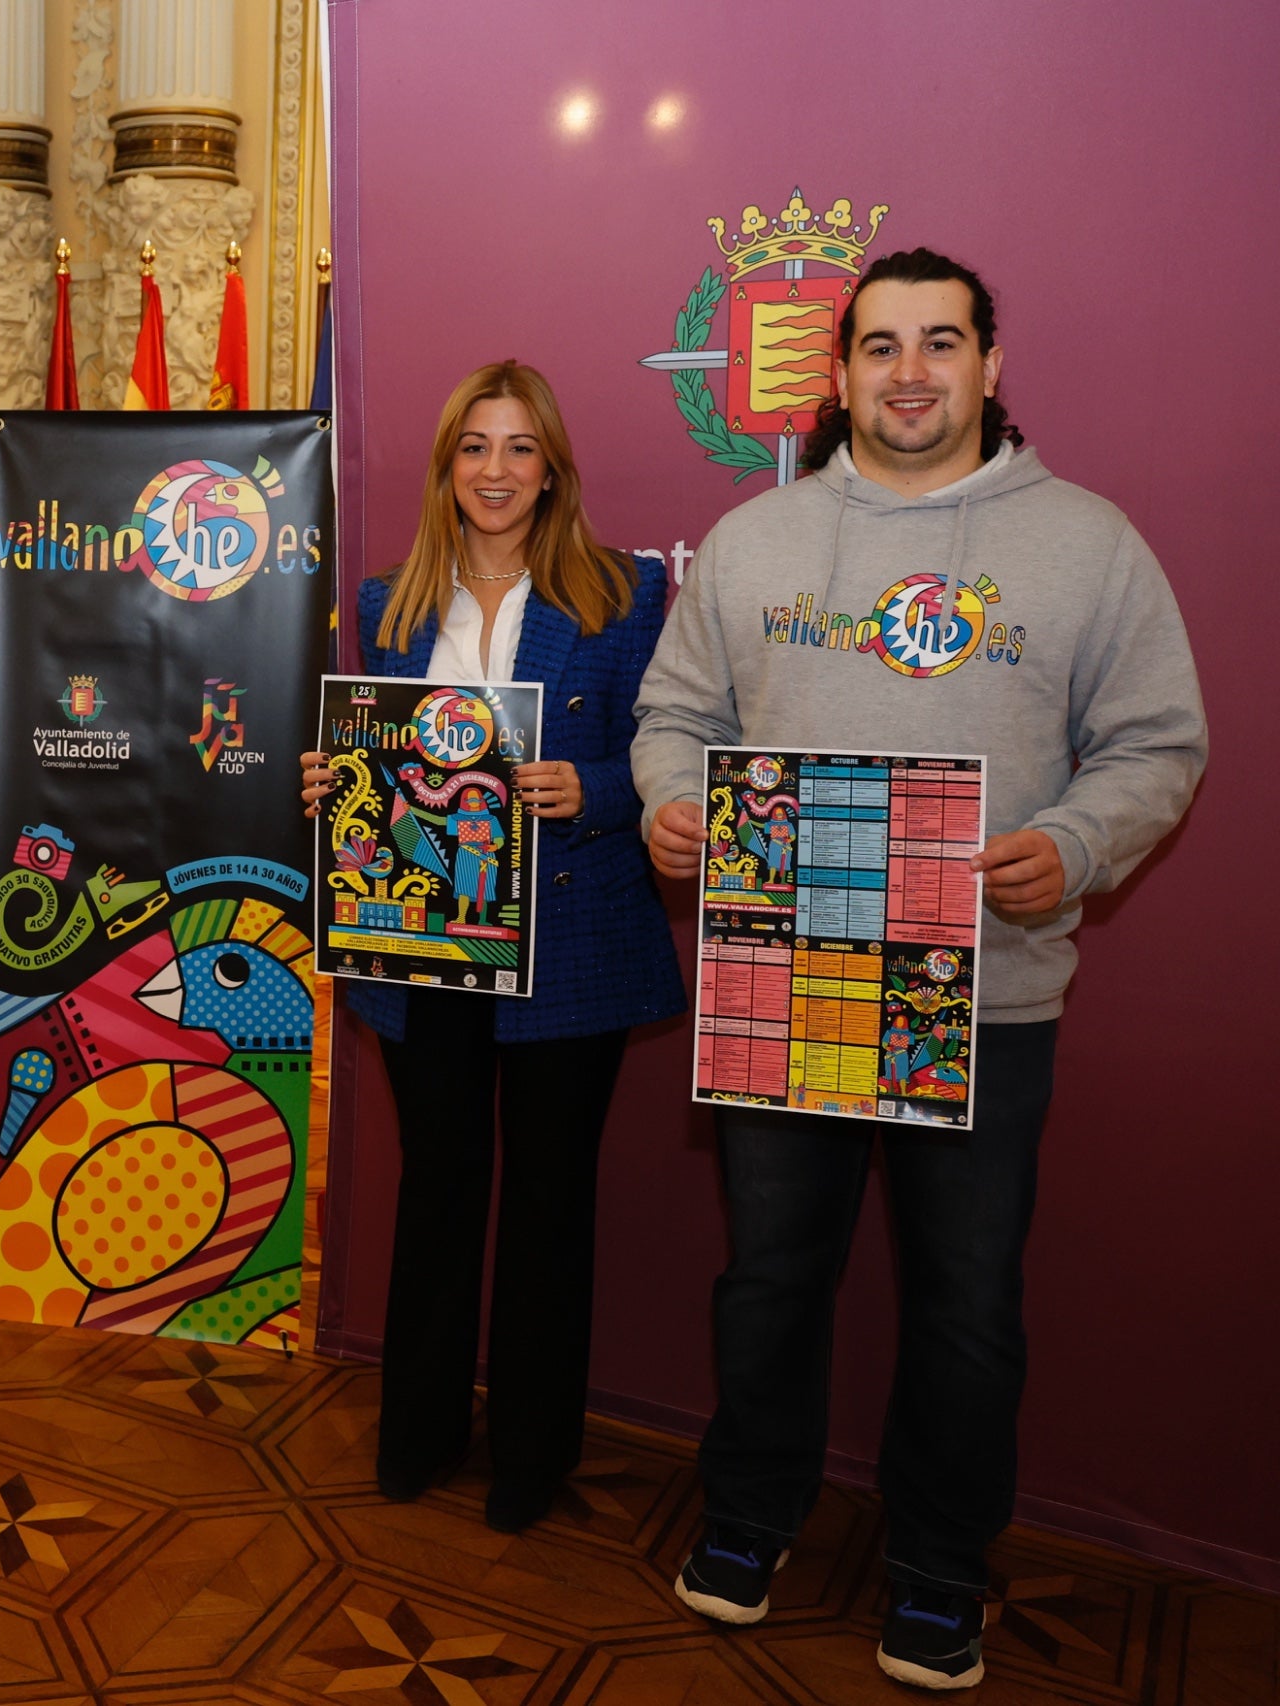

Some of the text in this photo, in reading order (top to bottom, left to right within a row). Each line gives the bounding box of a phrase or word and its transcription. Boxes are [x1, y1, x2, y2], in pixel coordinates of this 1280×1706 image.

[358, 686, 370, 696] 25
[33, 727, 130, 740] Ayuntamiento de
[33, 739, 130, 759] Valladolid
[220, 751, 265, 763] JUVEN
[830, 757, 859, 765] OCTUBRE
[77, 761, 87, 769] de
[217, 763, 245, 774] TUD
[917, 761, 956, 769] NOVIEMBRE
[460, 774, 498, 788] DICIEMBRE
[16, 874, 30, 885] DE
[173, 863, 303, 894] JÓVENES DE 14 A 30 AÑOS
[29, 877, 55, 928] ACTIVIDADES
[707, 903, 792, 914] WWW.VALLANOCHE.ES
[33, 916, 87, 966] GRATUITAS
[727, 936, 765, 945] NOVIEMBRE
[820, 942, 854, 951] DICIEMBRE
